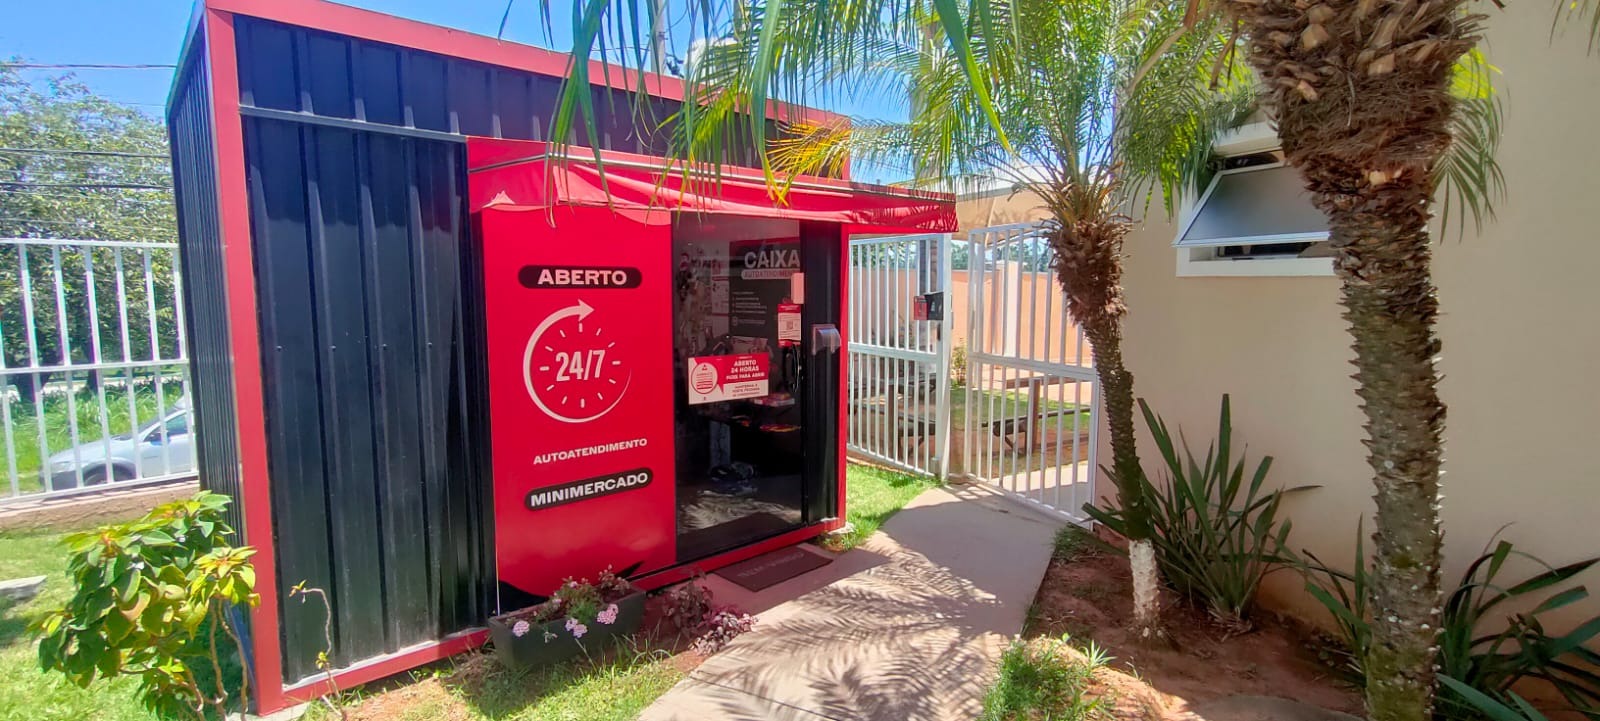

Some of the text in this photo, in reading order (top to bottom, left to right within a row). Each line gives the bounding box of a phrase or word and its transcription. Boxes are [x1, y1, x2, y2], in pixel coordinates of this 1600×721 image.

[744, 249, 801, 269] CAIXA
[537, 269, 628, 285] ABERTO
[555, 349, 606, 382] 24/7
[733, 359, 757, 367] ABERTO
[533, 438, 648, 465] AUTOATENDIMENTO
[530, 472, 648, 507] MINIMERCADO
